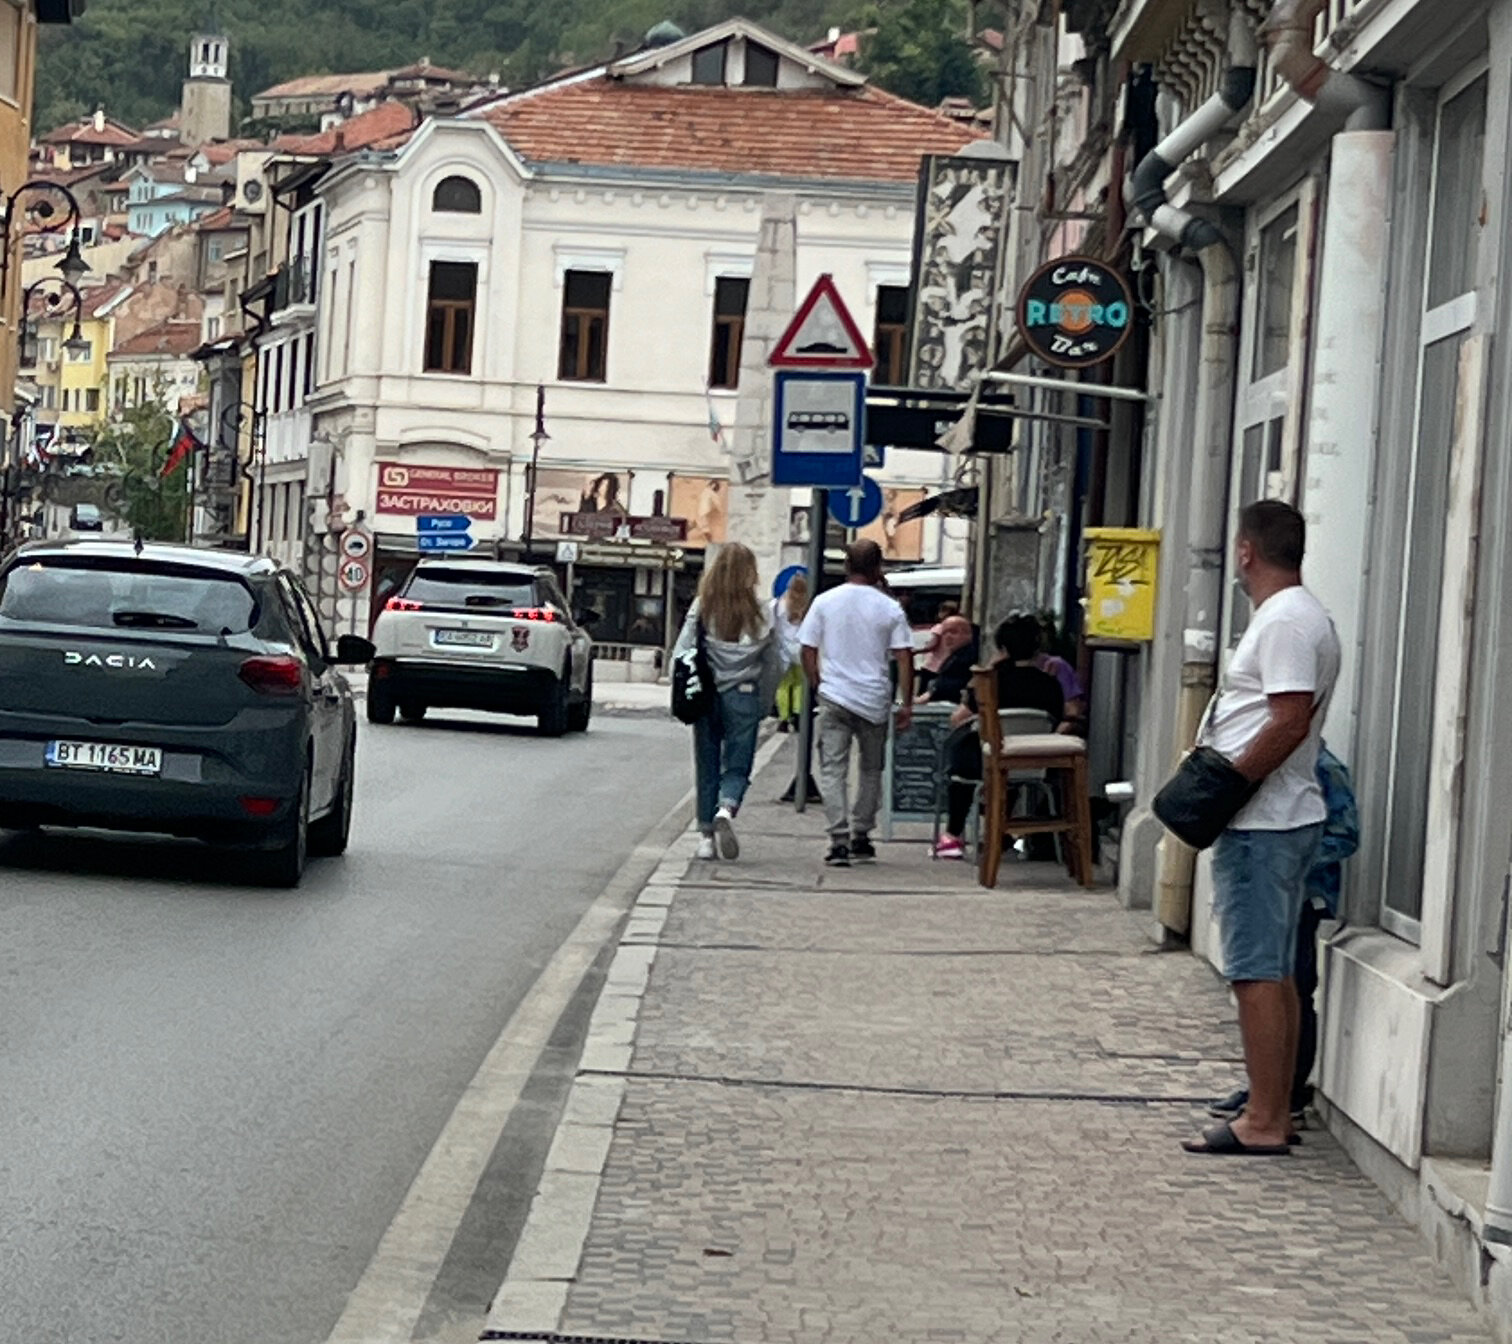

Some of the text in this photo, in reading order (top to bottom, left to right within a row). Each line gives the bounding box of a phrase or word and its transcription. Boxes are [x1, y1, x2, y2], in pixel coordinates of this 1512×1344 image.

[1026, 298, 1128, 328] RETRO
[379, 494, 494, 514] ЗАСТРАХОВКИ
[64, 651, 156, 670] DACIA
[88, 744, 130, 764] 1165
